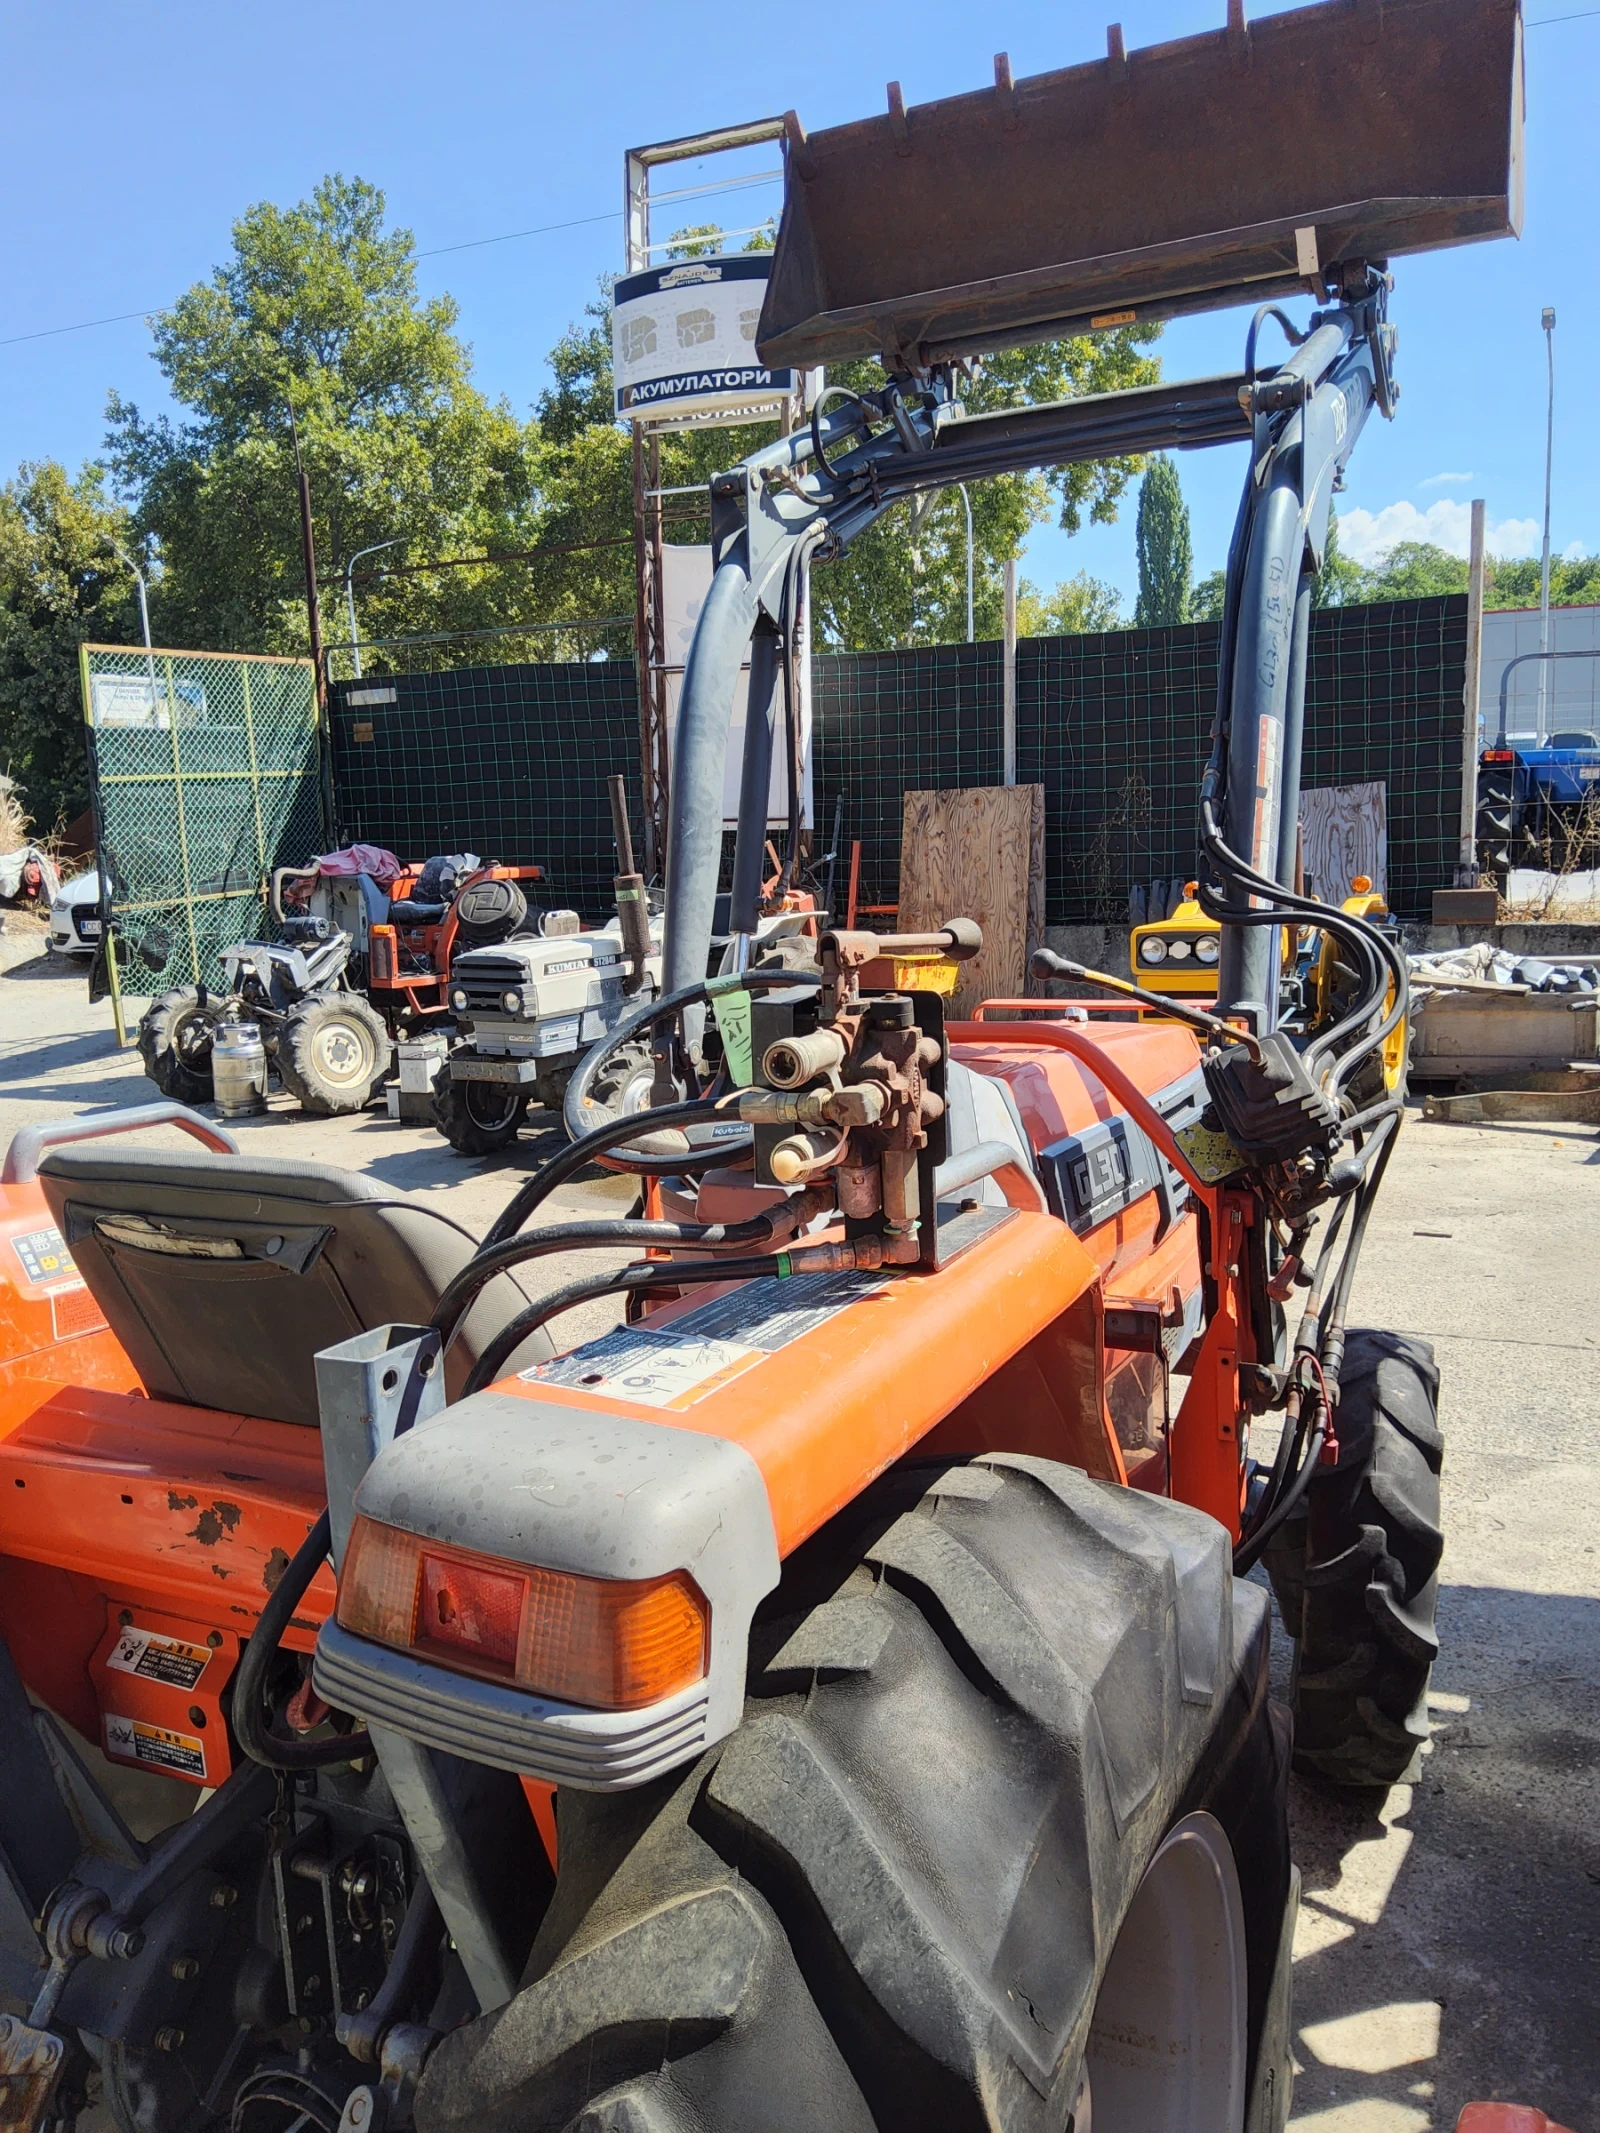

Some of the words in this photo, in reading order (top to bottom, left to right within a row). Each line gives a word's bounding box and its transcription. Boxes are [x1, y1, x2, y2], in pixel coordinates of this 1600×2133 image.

[662, 269, 718, 283] SZNAJDER
[629, 370, 772, 403] АКУМУЛАТОРИ
[547, 959, 589, 974] KUMIAI
[714, 1125, 751, 1136] Kubota
